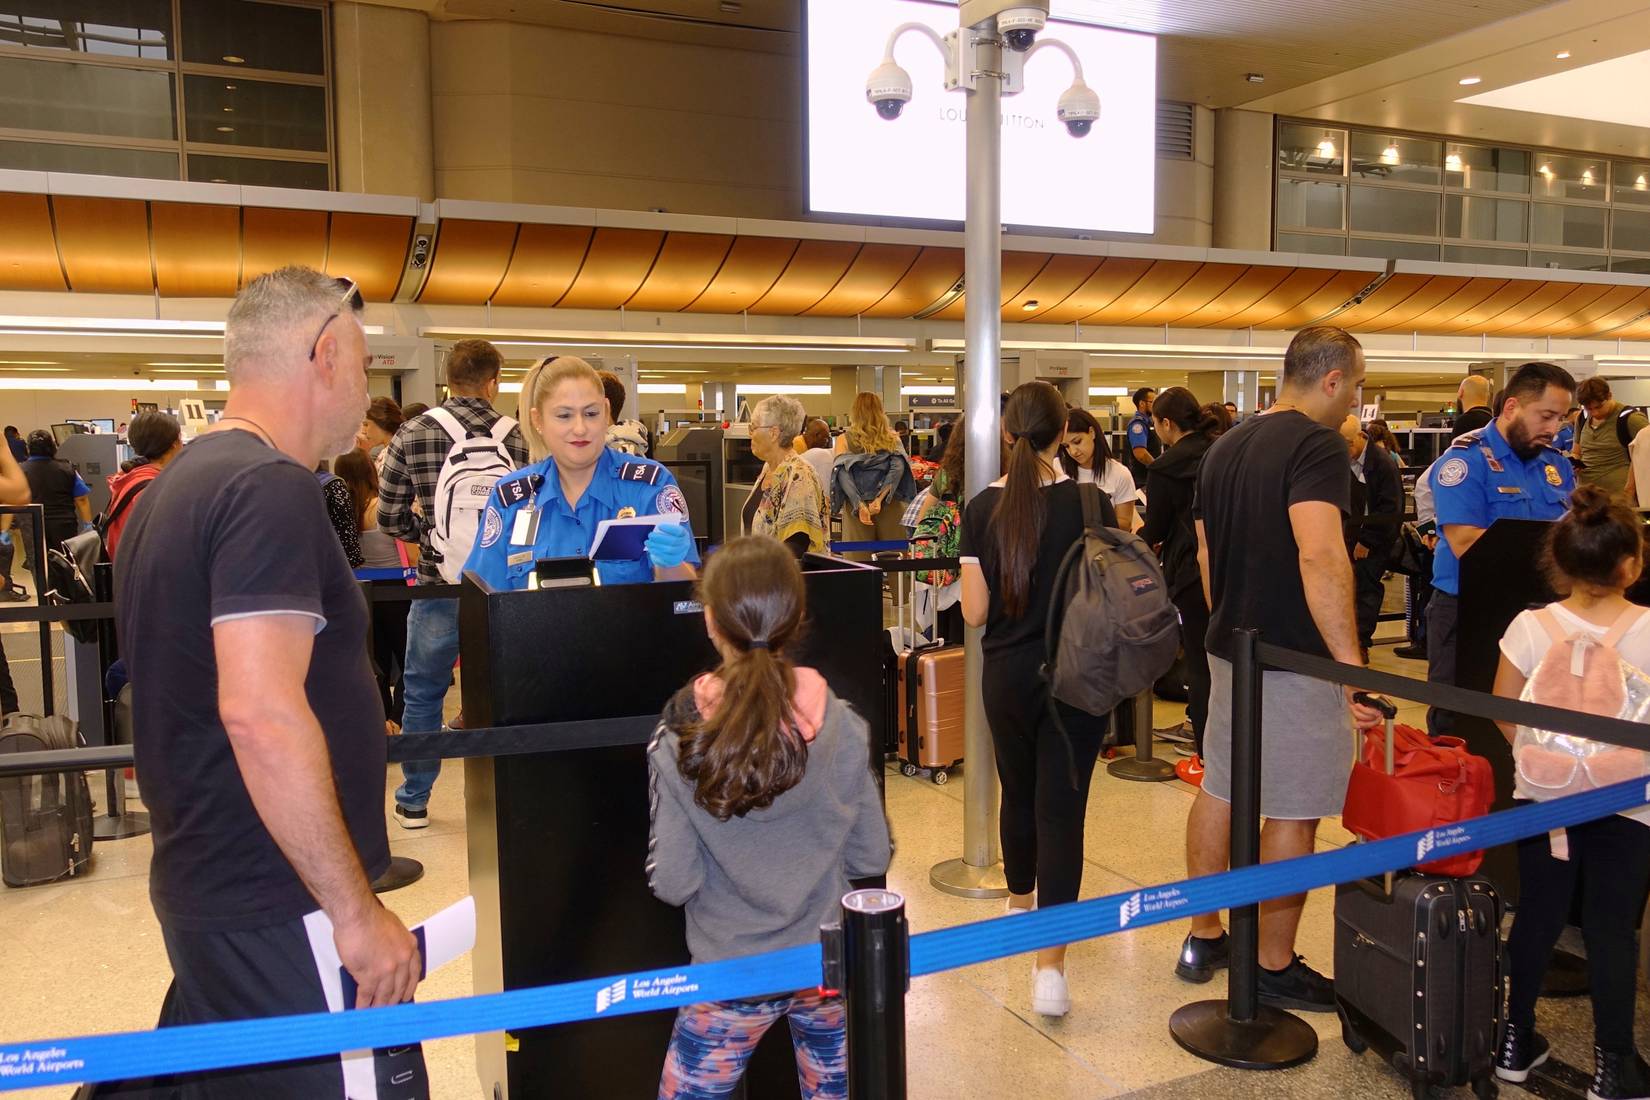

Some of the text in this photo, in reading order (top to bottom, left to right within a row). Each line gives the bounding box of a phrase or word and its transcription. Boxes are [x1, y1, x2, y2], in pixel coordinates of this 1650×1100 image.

[632, 464, 647, 480] TSA
[510, 480, 524, 500] TSA
[1144, 888, 1180, 902] Los Angeles
[1144, 898, 1188, 912] World Airports
[633, 974, 688, 989] Los Angeles
[633, 983, 699, 998] World Airports
[0, 1047, 67, 1063] Los Angeles
[0, 1059, 84, 1076] World Airports
